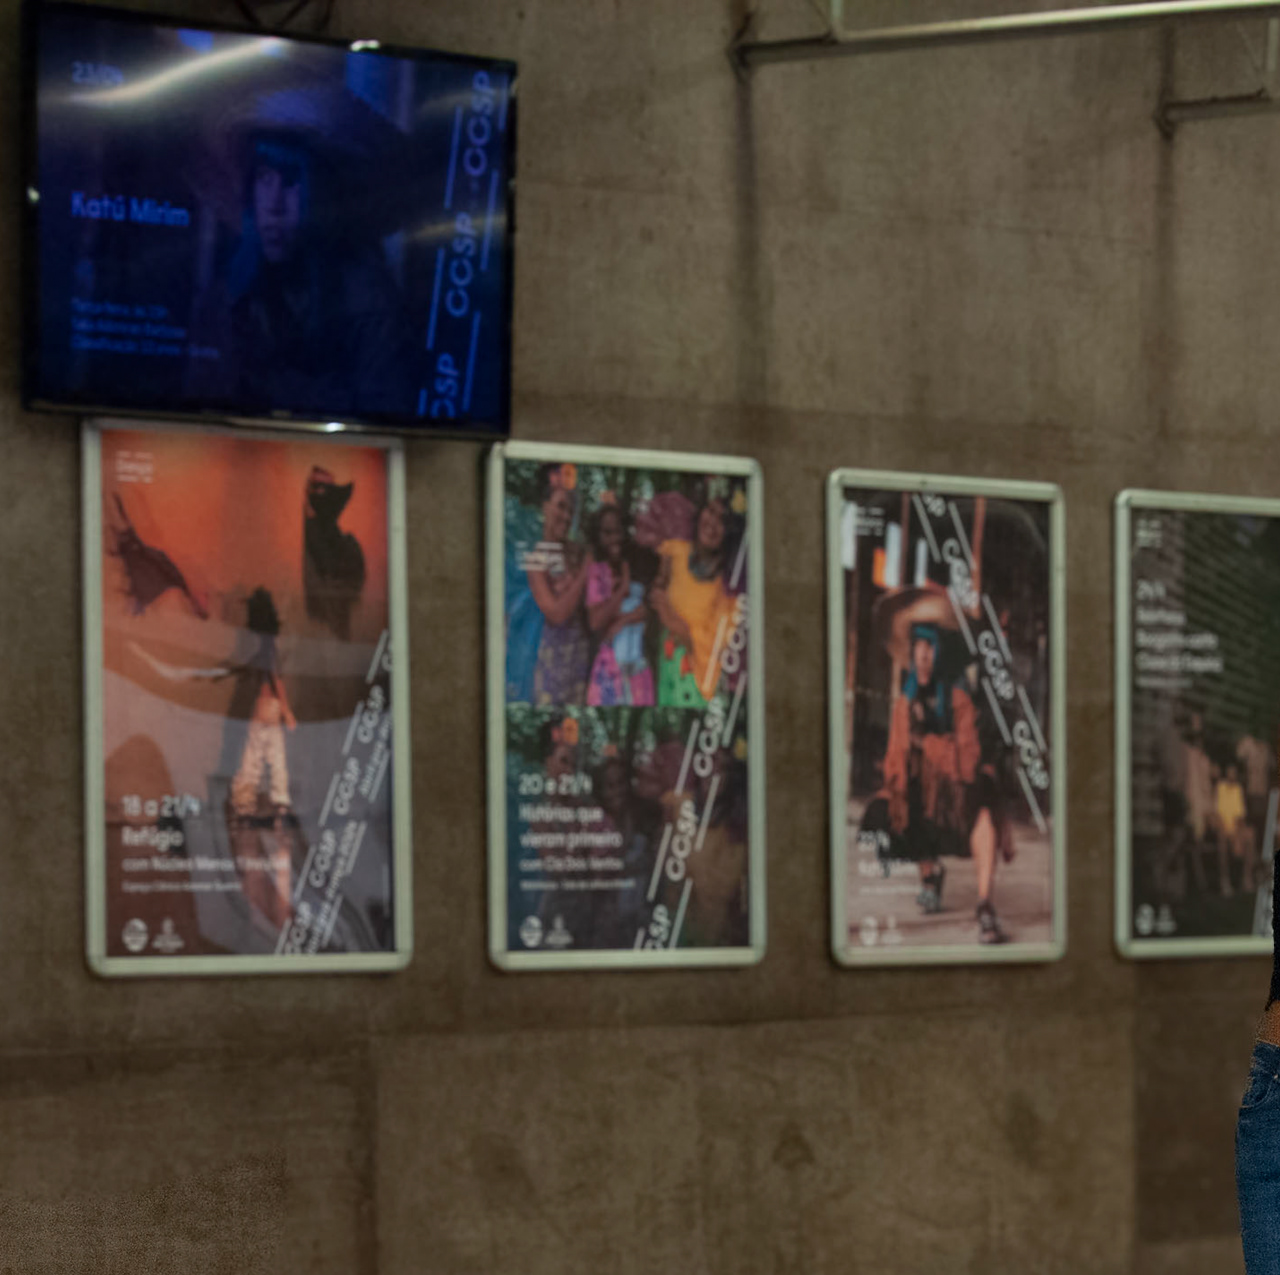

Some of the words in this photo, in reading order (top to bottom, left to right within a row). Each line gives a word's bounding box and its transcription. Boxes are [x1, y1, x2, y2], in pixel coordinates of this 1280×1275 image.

[444, 211, 477, 319] CCSP
[693, 697, 727, 778] CCSP
[665, 799, 697, 881] CCSP
